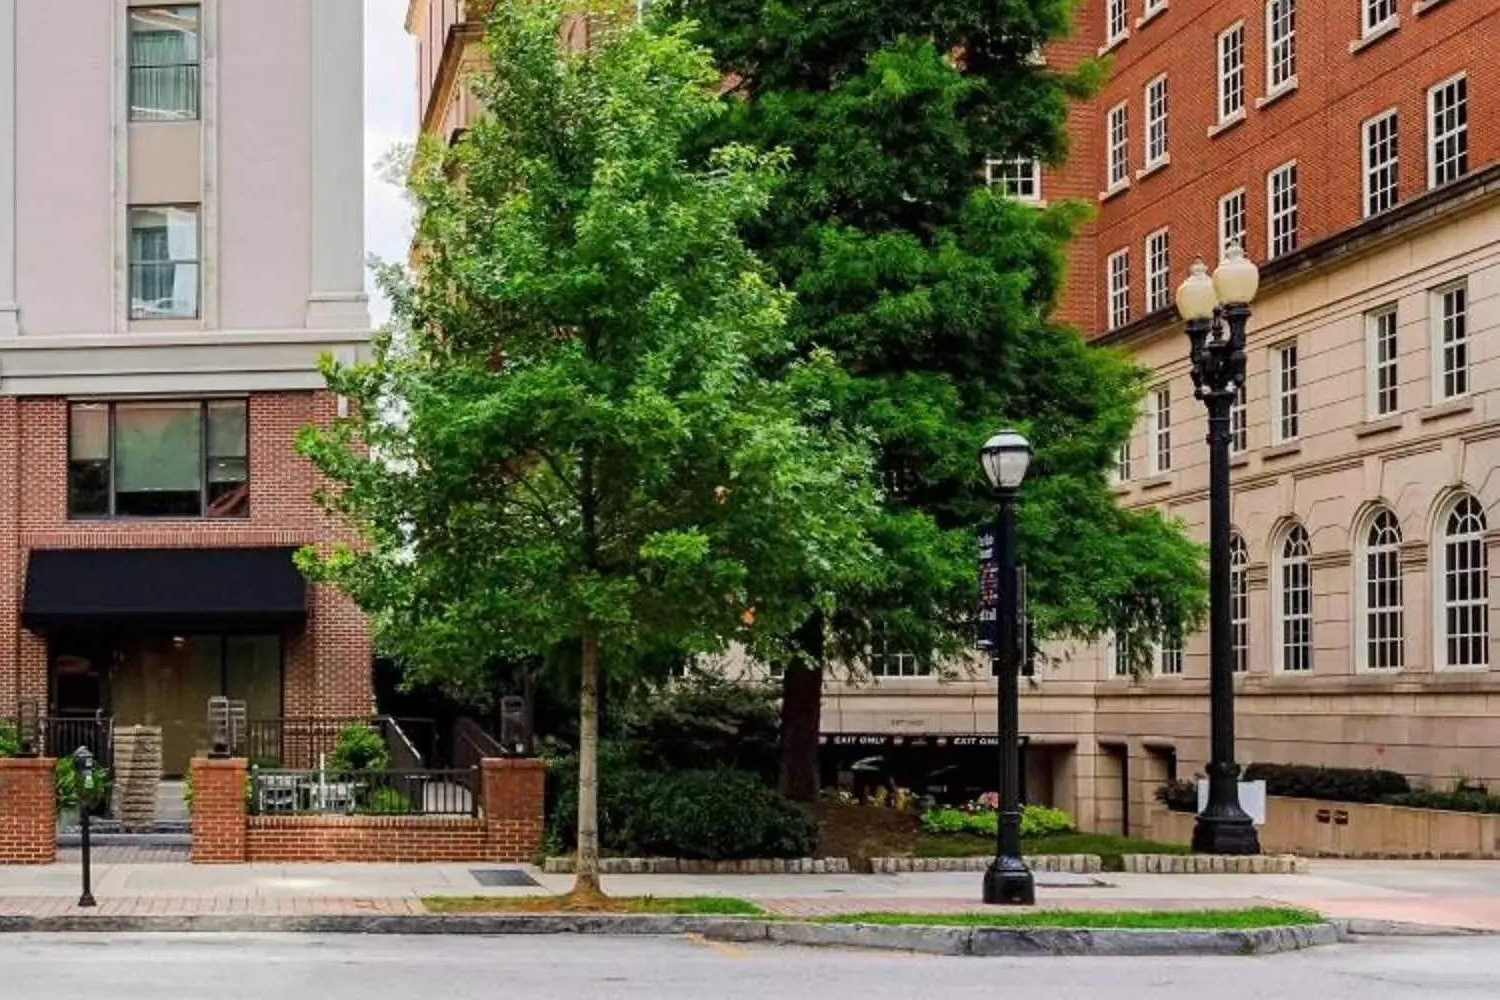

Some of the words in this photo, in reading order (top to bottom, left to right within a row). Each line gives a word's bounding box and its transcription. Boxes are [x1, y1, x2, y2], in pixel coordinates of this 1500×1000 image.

[833, 736, 855, 745] EXIT
[859, 736, 887, 745] ONLY
[953, 736, 976, 745] EXIT
[979, 737, 999, 746] ONL
